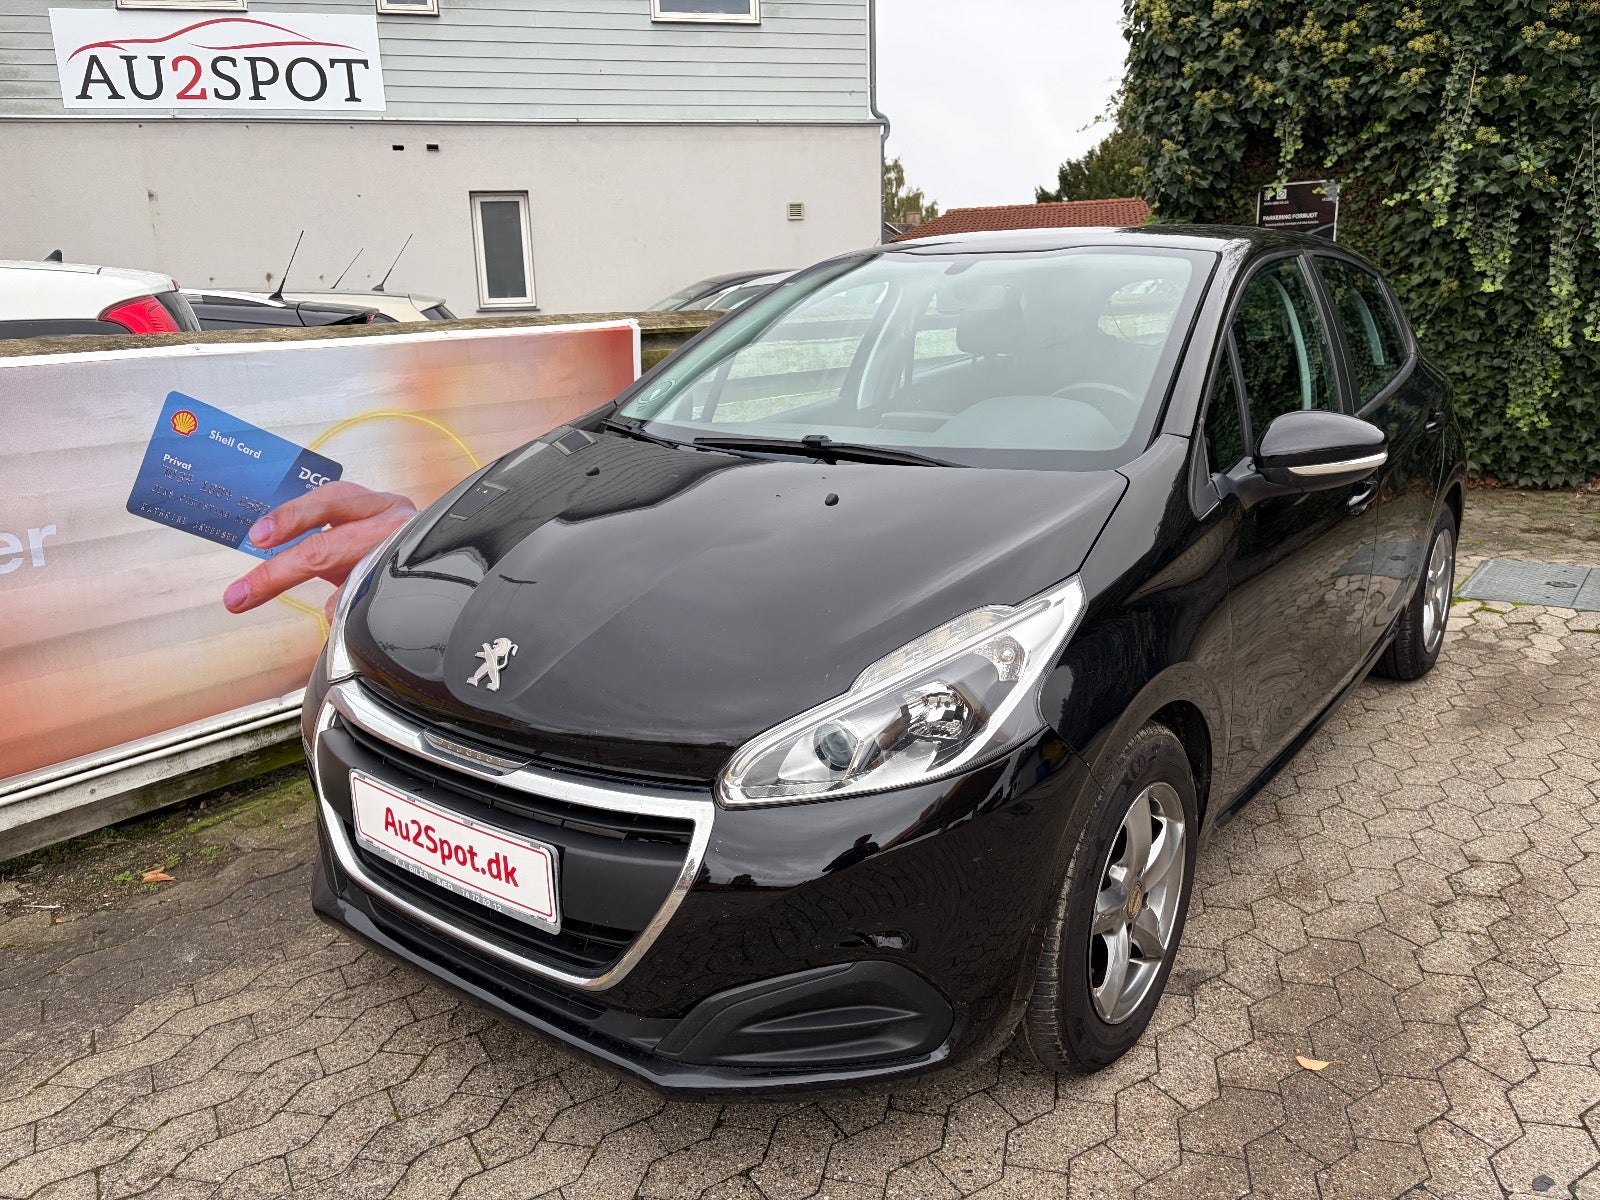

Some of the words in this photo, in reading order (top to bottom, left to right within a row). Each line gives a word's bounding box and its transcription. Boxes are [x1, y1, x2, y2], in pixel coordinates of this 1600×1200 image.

[75, 54, 370, 103] AU2SPOT
[162, 453, 193, 471] Privat
[208, 429, 235, 448] Shell
[236, 442, 262, 459] Card
[298, 466, 331, 486] DCC
[383, 806, 520, 888] Au2Spot.dk
[408, 864, 430, 880] BILER
[471, 893, 481, 903] 72
[493, 902, 503, 912] 12
